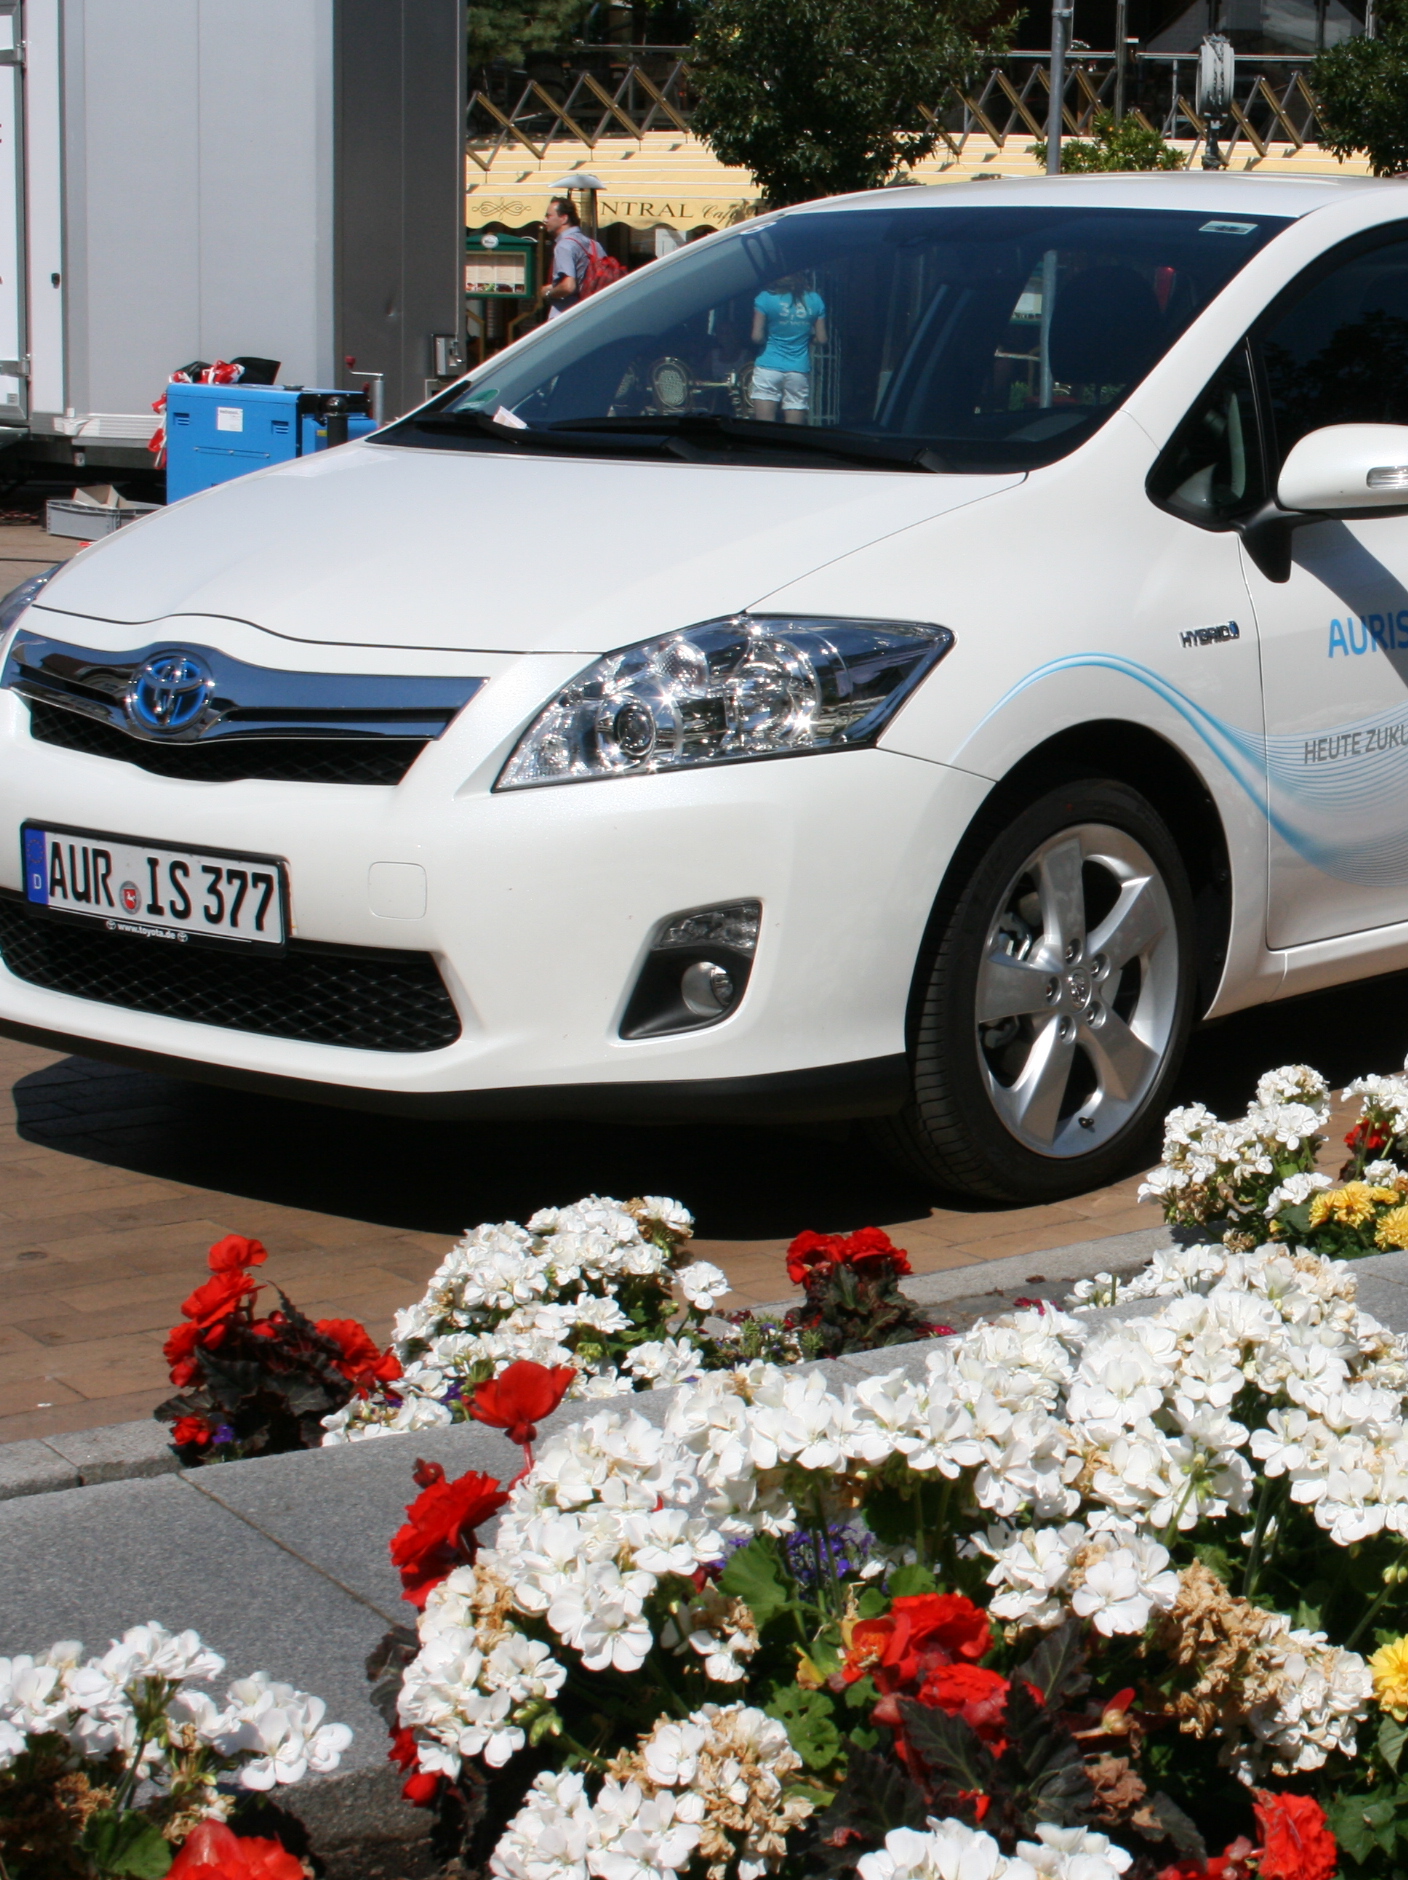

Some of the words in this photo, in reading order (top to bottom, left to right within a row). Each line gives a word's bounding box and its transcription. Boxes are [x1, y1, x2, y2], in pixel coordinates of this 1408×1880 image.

[600, 201, 694, 219] NTRAL
[1180, 625, 1230, 648] HYBRID
[1304, 731, 1361, 765] HEUTE
[33, 873, 42, 890] D
[49, 841, 115, 907] AUR
[146, 856, 192, 920] IS
[201, 864, 274, 932] 377
[117, 923, 176, 940] www.toyota.de
